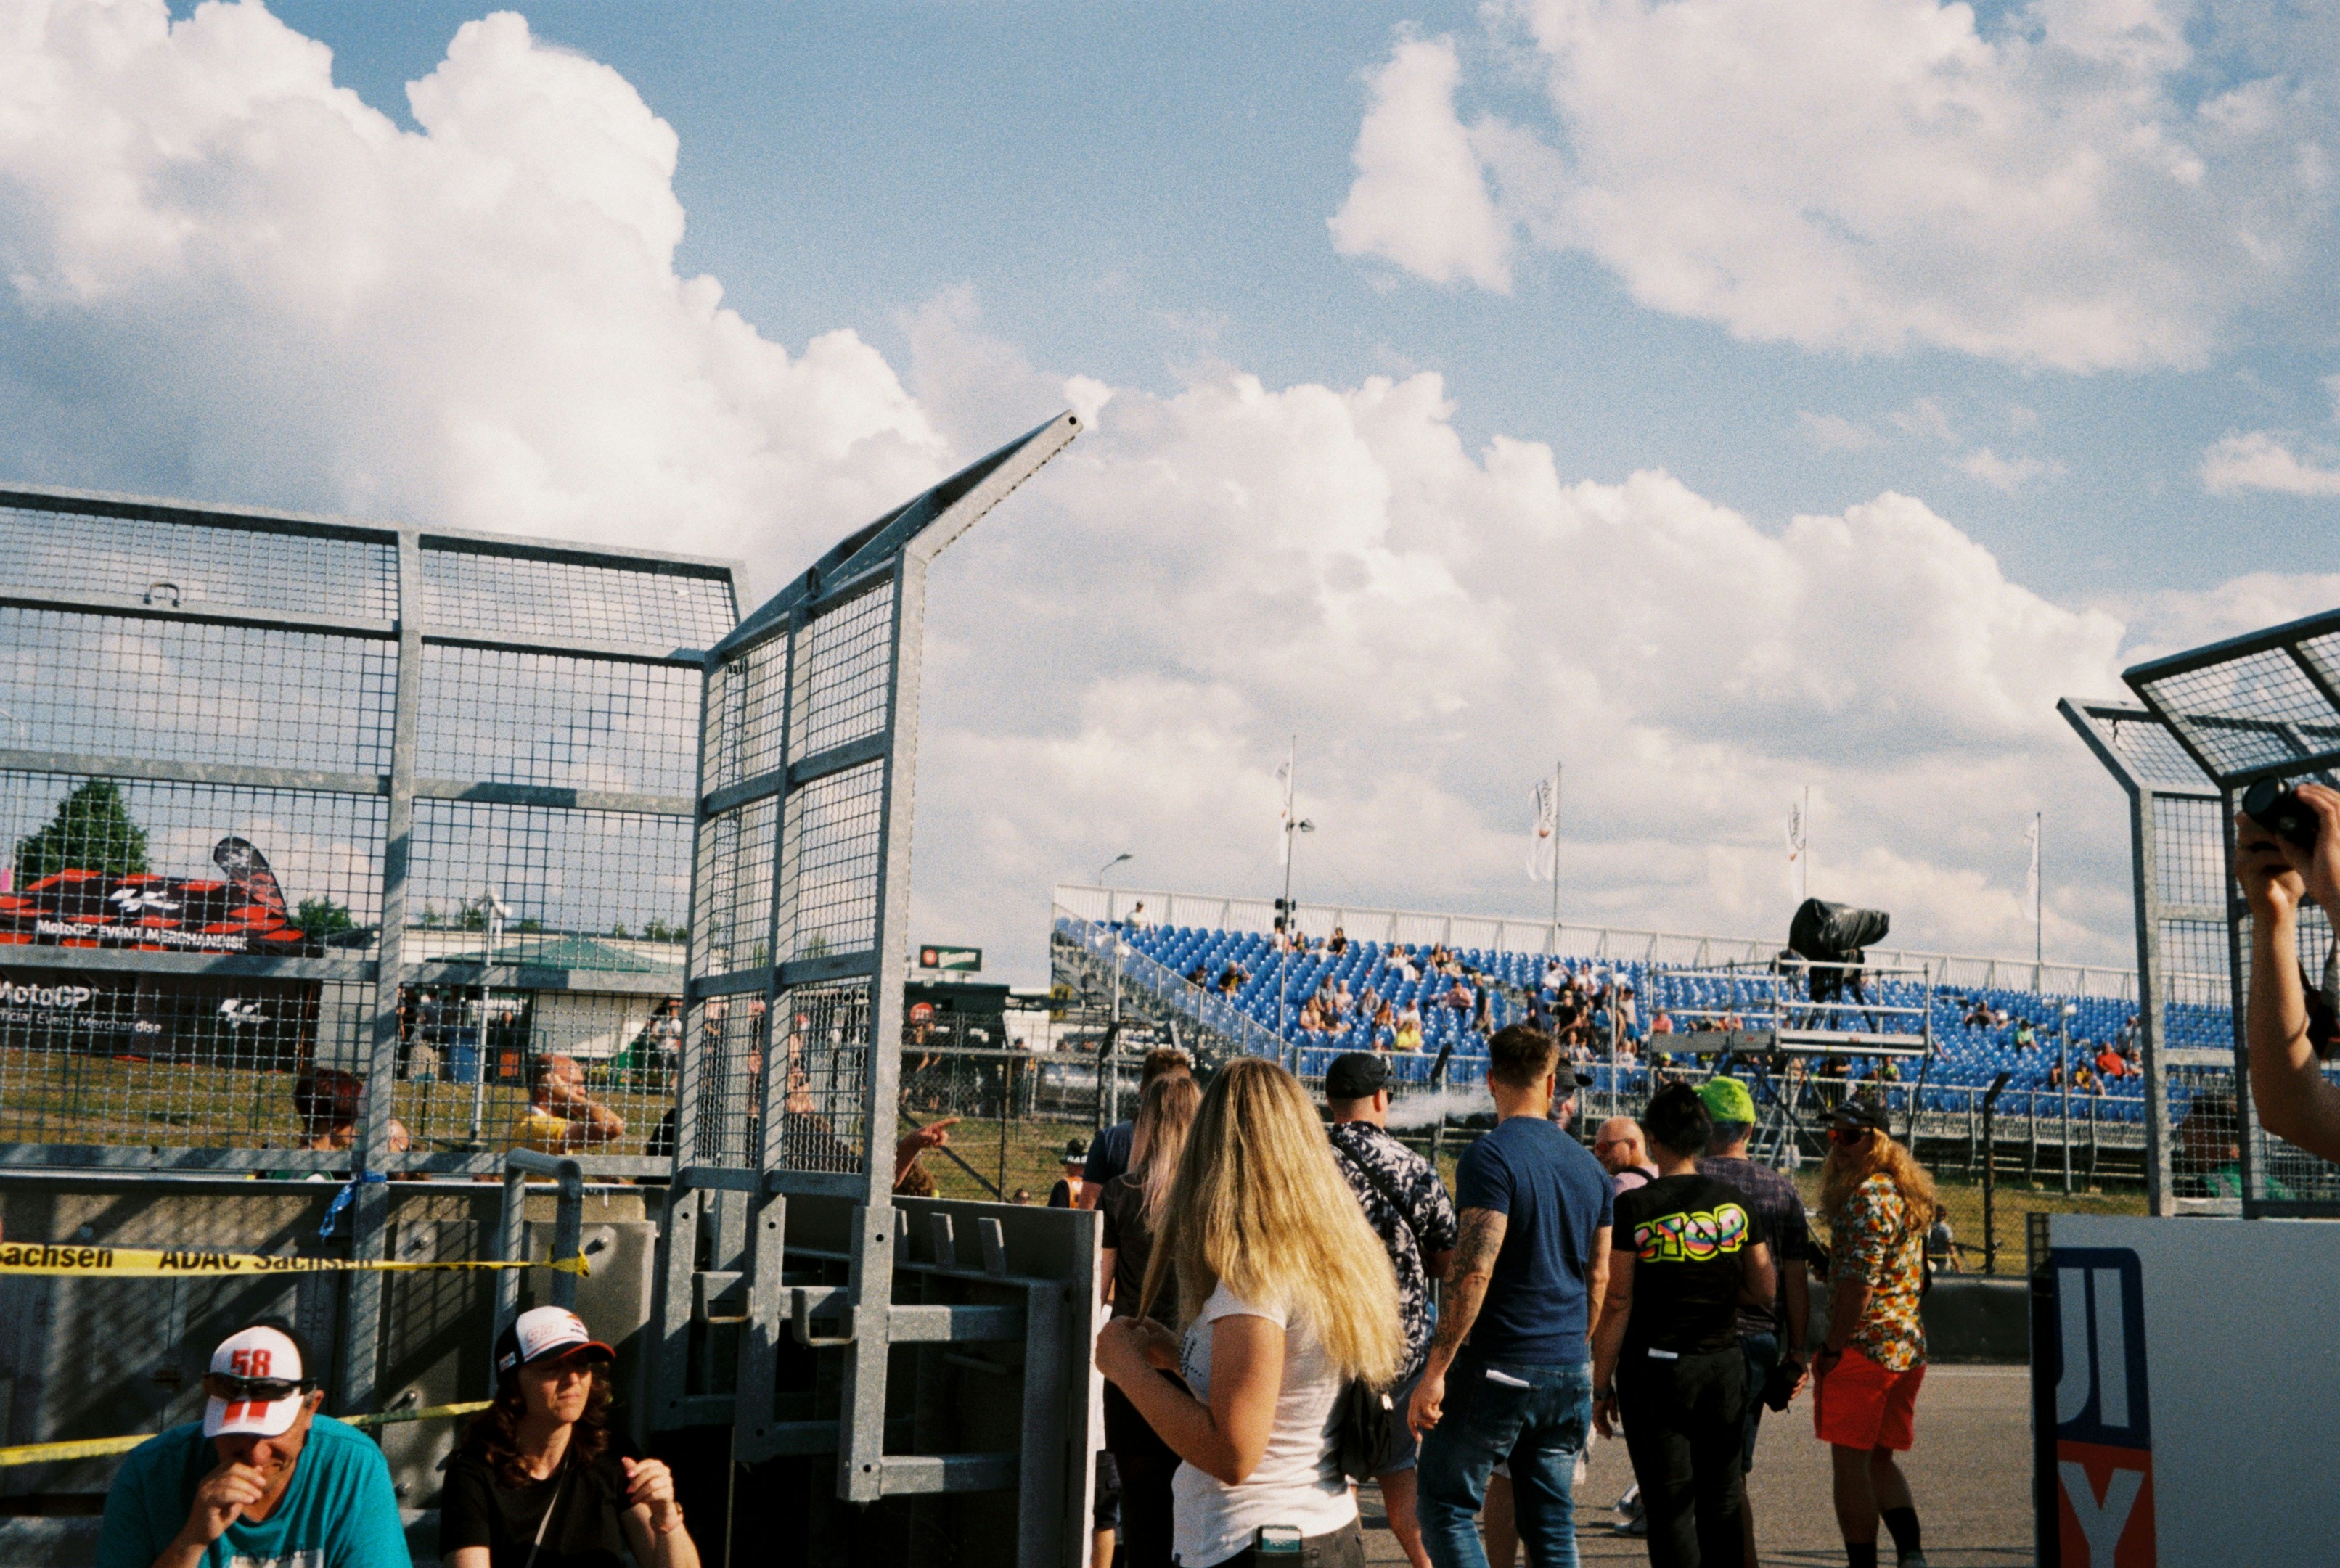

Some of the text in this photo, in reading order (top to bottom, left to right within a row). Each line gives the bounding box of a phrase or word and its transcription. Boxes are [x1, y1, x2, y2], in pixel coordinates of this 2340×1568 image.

[99, 925, 142, 937] EVENT
[1635, 1202, 1749, 1263] STOP
[0, 1247, 113, 1268] achsen
[158, 1251, 242, 1270] ADAC
[231, 1348, 271, 1377] 58
